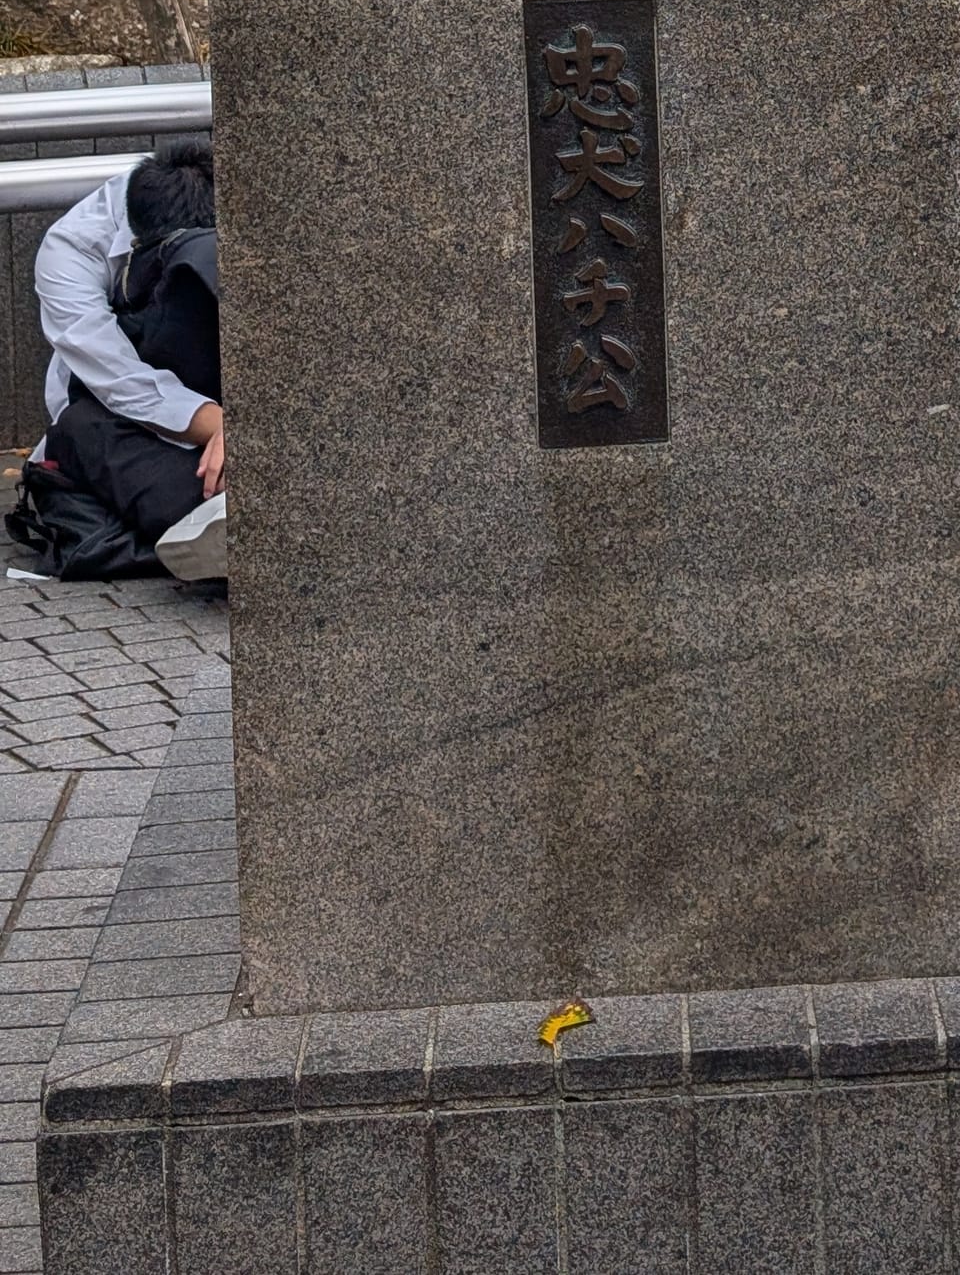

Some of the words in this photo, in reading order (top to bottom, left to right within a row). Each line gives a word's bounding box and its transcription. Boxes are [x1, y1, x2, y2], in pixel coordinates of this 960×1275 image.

[540, 24, 645, 414] 忠犬ハチ公
